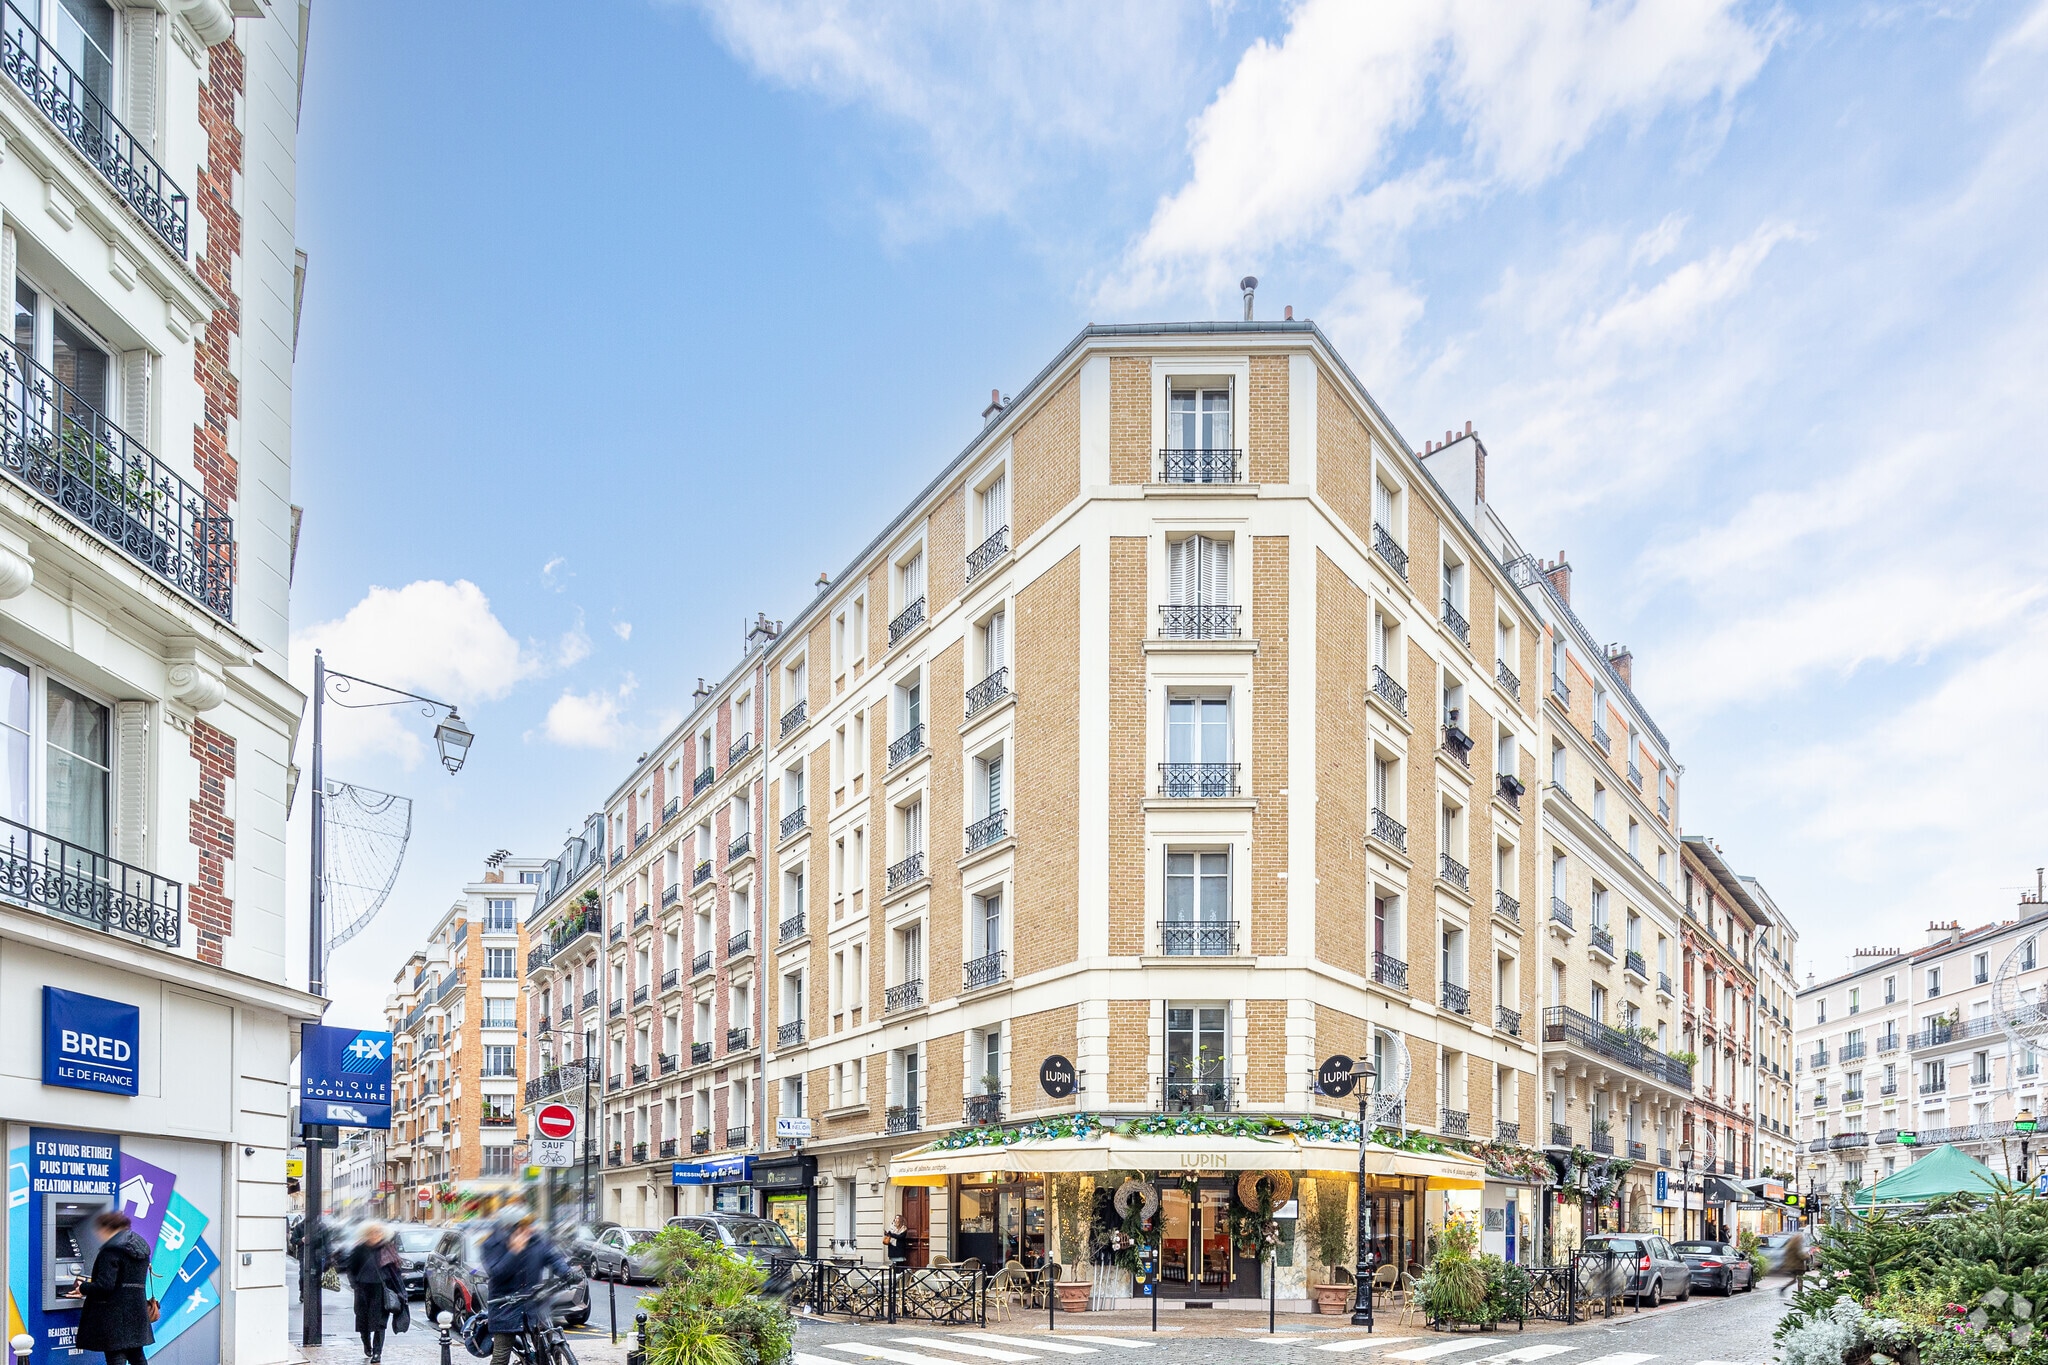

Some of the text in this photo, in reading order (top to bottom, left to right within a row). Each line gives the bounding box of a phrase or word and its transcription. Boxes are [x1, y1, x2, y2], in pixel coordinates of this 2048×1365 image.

[62, 1029, 131, 1062] BRED
[58, 1066, 132, 1087] ILE DE FRANCE
[307, 1077, 385, 1091] BANQUE
[1046, 1070, 1071, 1084] LUPIN
[307, 1087, 386, 1101] POPULAIRE
[36, 1141, 112, 1160] ET SI VOUS RETIRIEZ
[541, 1141, 565, 1149] SAUF
[1180, 1153, 1227, 1168] LUPIN
[40, 1160, 61, 1174] PLUS
[87, 1163, 110, 1177] VRAIE
[33, 1178, 117, 1195] RELATION BANCAIRE ?
[59, 1336, 72, 1345] AVEC
